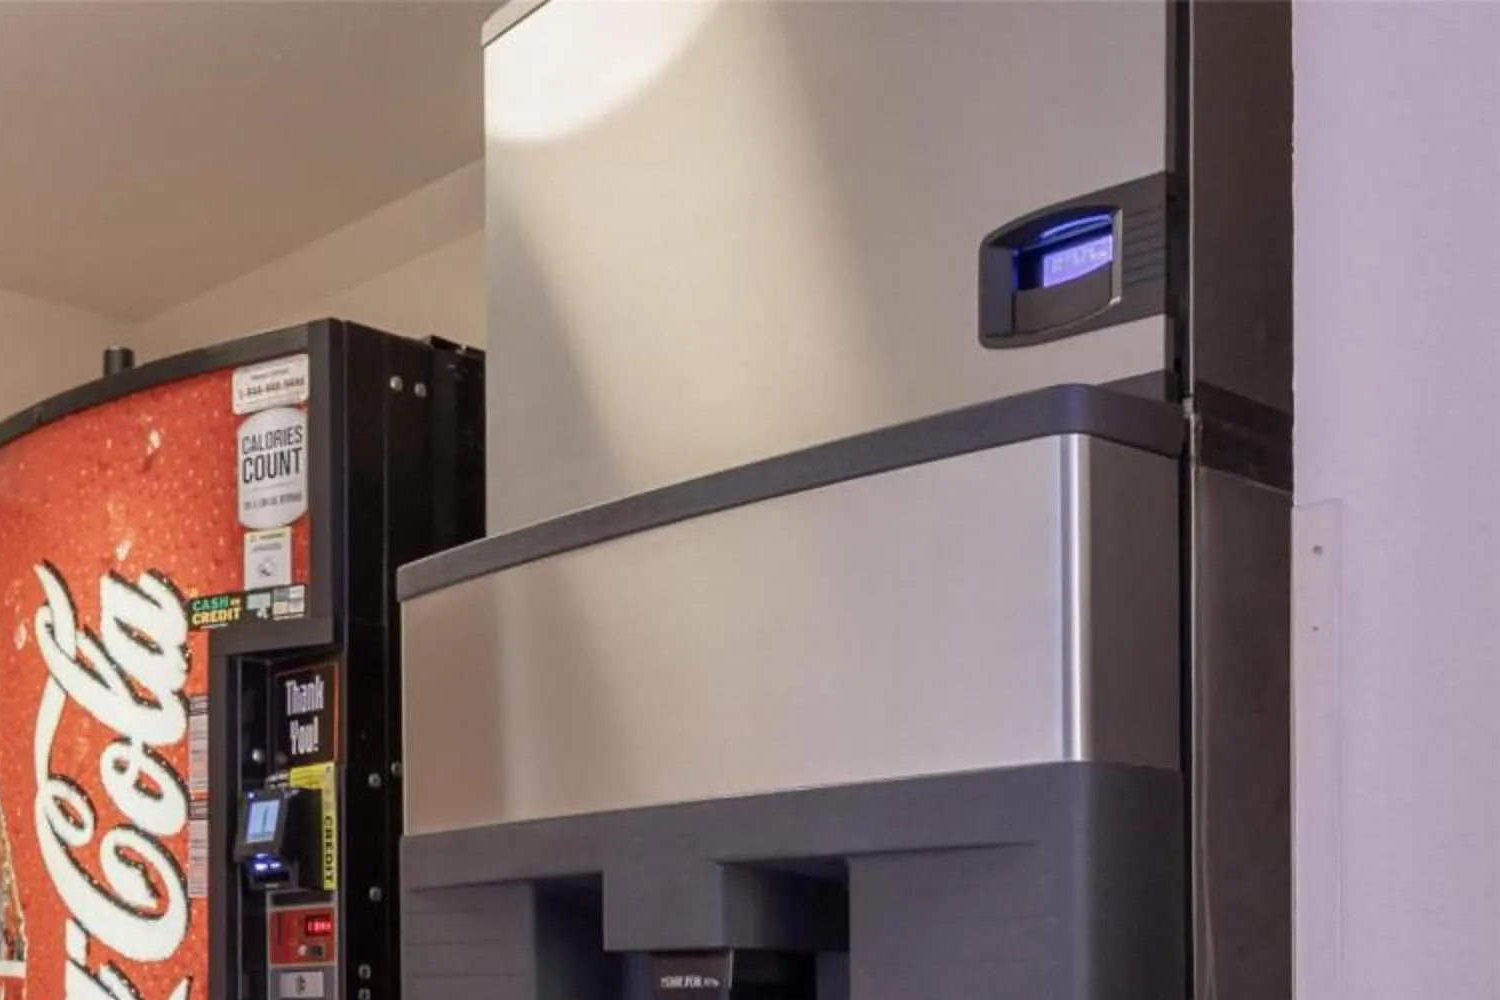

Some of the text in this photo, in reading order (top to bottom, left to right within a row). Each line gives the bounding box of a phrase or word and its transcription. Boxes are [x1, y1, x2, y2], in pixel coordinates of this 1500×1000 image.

[242, 424, 303, 455] CALORIES
[243, 447, 303, 484] COUNT
[192, 595, 229, 611] CASH
[192, 606, 241, 626] CREDIT
[285, 674, 325, 716] Thank
[289, 716, 319, 755] You!
[323, 815, 334, 881] CREDIT
